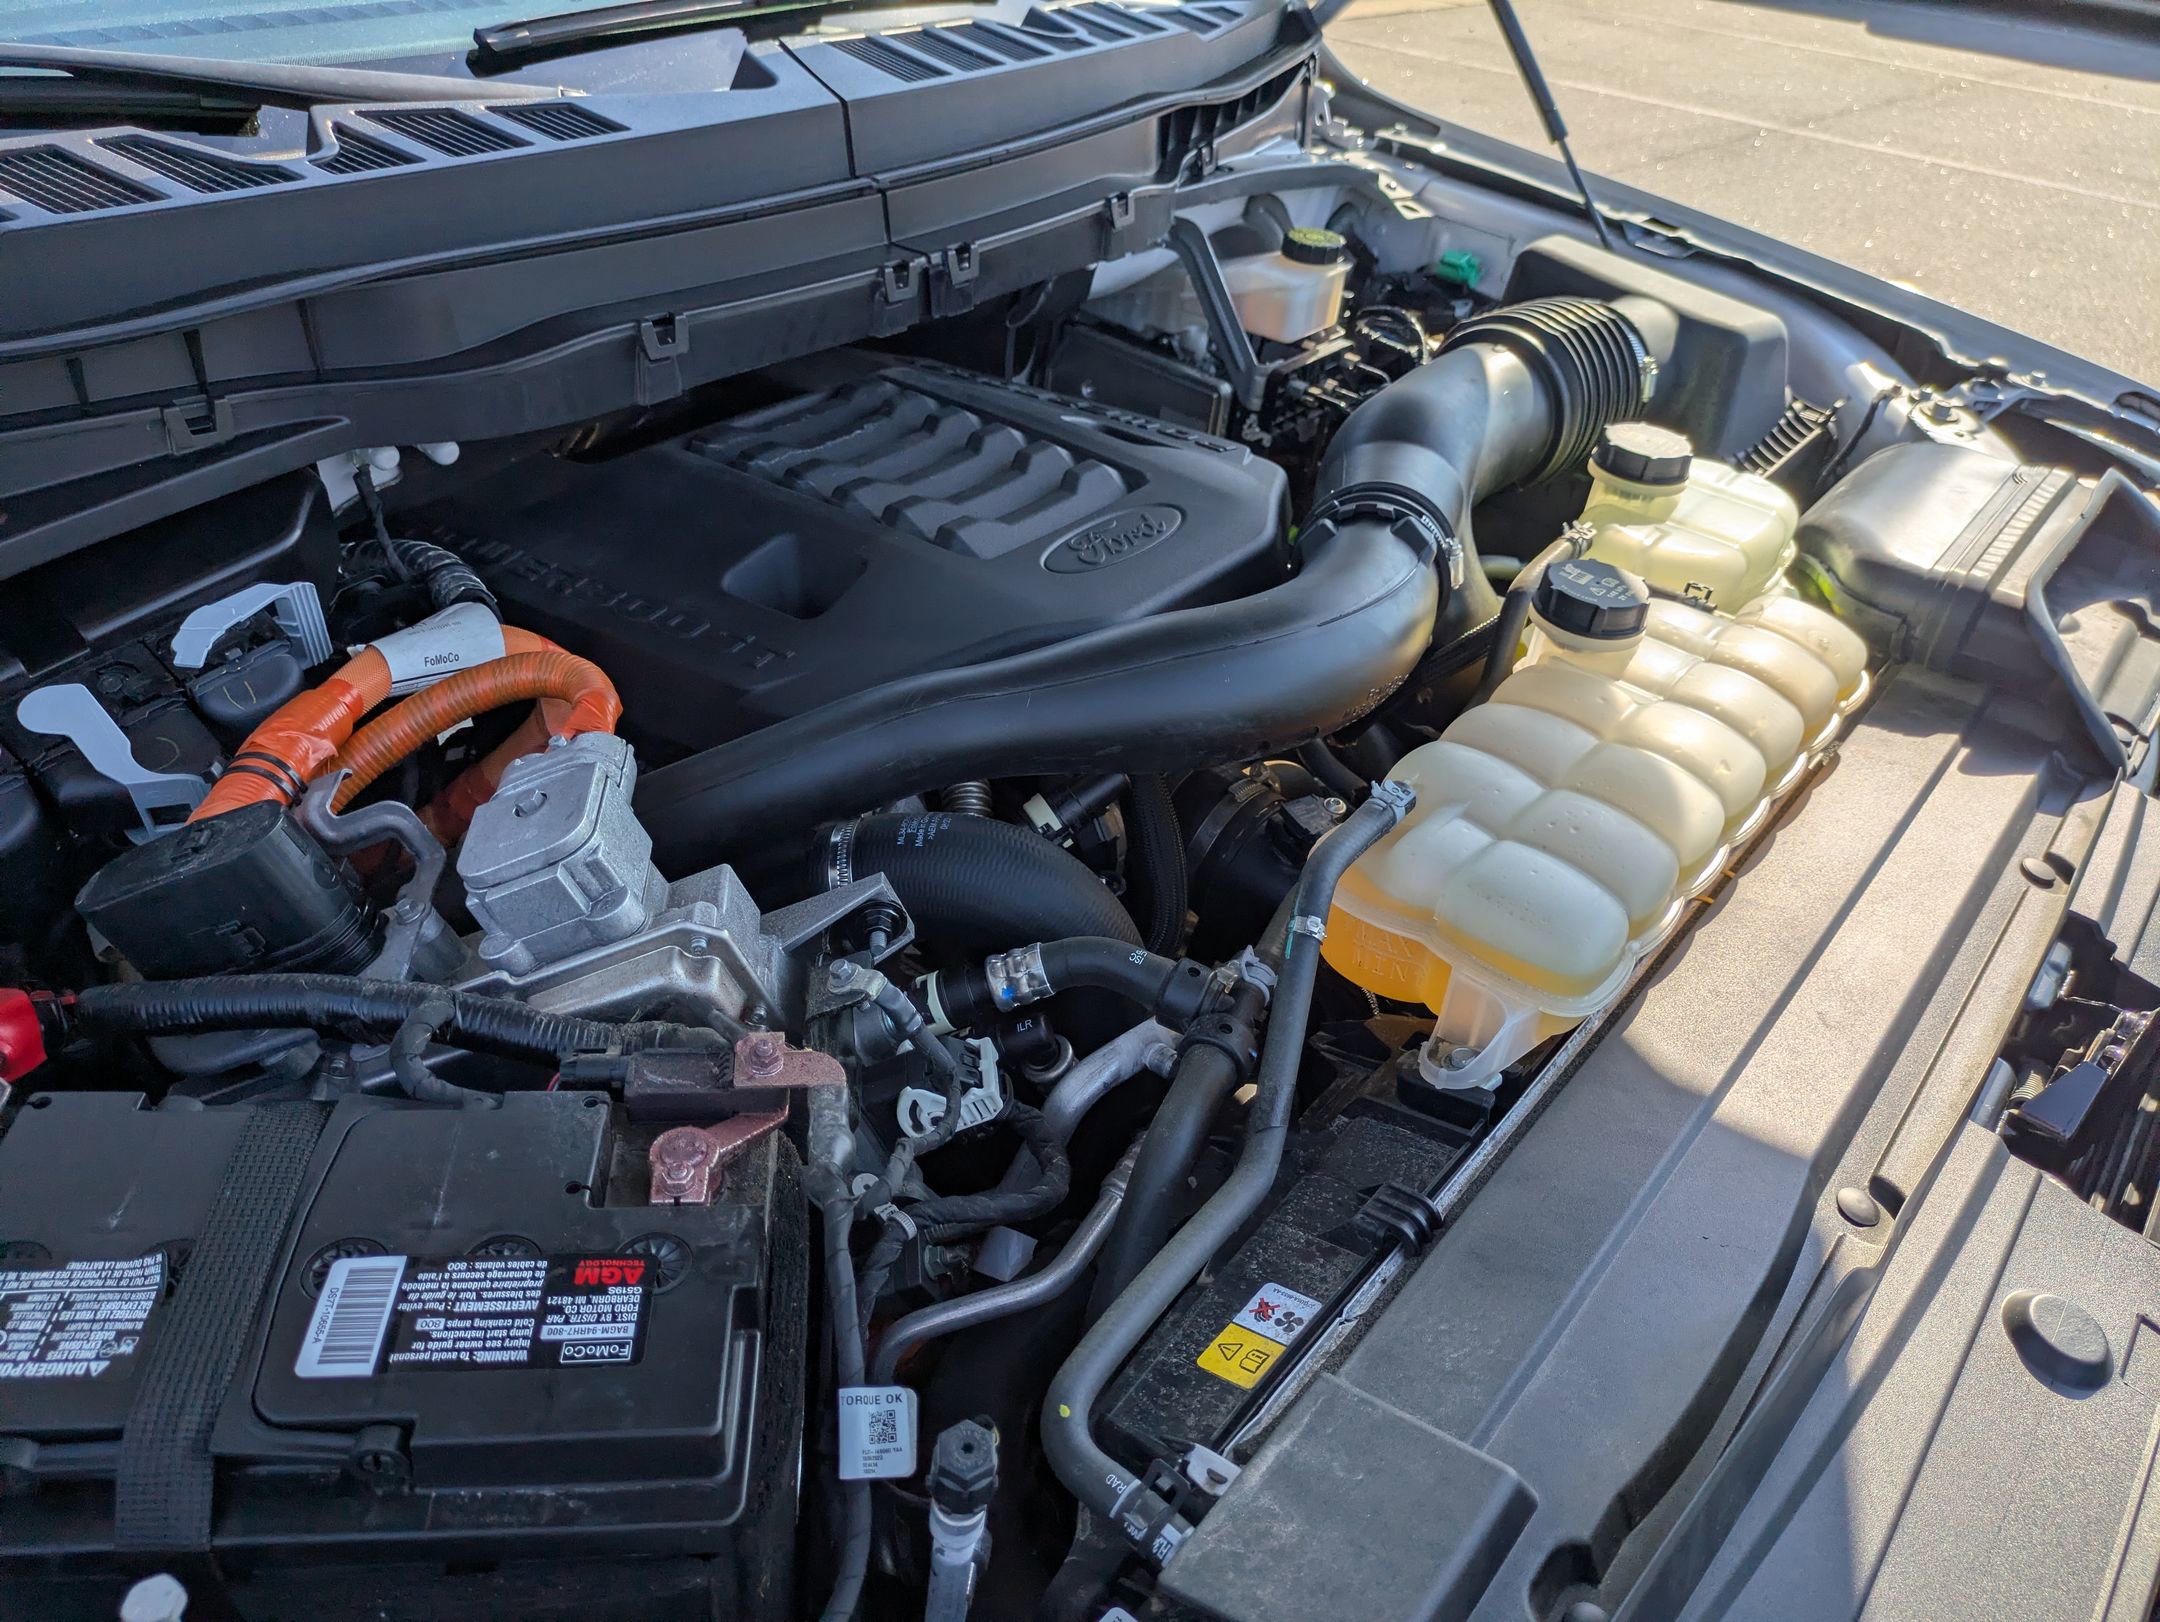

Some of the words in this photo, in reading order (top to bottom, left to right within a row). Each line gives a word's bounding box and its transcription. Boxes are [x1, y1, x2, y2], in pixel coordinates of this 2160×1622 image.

[1068, 513, 1167, 565] Ford
[424, 652, 460, 668] FoMoCo
[1129, 952, 1144, 965] ISC
[1016, 1019, 1033, 1032] ILR
[448, 1262, 467, 1270] 800
[475, 1262, 505, 1270] volants
[507, 1261, 535, 1269] cables
[536, 1260, 547, 1269] de
[452, 1272, 485, 1280] secours
[488, 1270, 532, 1280] demarrage
[535, 1271, 545, 1279] de
[574, 1267, 644, 1285] AGM
[402, 1282, 439, 1291] methode
[442, 1282, 450, 1290] la
[493, 1280, 544, 1289] proprietaire
[421, 1291, 446, 1301] guide
[448, 1292, 456, 1300] le
[459, 1292, 476, 1300] Voir
[480, 1291, 524, 1299] blessures.
[526, 1290, 541, 1299] des
[589, 1295, 640, 1303] DEARBORN,
[547, 1296, 574, 1304] 48121
[575, 1296, 586, 1304] MI
[425, 1302, 445, 1310] Pour
[454, 1300, 539, 1310] AVERTISSEMENT
[563, 1305, 577, 1313] CO.
[580, 1304, 612, 1313] MOTOR
[615, 1304, 639, 1312] FORD
[312, 1287, 339, 1343] DS7T-10655-A
[546, 1315, 565, 1323] PAR
[568, 1314, 597, 1322] DISTR.
[599, 1314, 612, 1322] BY
[615, 1313, 637, 1321] DIST.
[421, 1320, 442, 1328] 800
[446, 1319, 472, 1328] amps
[474, 1319, 512, 1328] cranking
[514, 1319, 535, 1327] Cold
[430, 1330, 484, 1339] instructions.
[486, 1330, 507, 1338] start
[510, 1328, 533, 1337] jump
[547, 1326, 628, 1335] BAGM-94RH7-800
[411, 1342, 425, 1350] for
[428, 1340, 453, 1350] guide
[455, 1340, 483, 1348] owner
[486, 1340, 502, 1348] see
[504, 1338, 530, 1348] injury
[564, 1344, 629, 1357] FoMoCo
[390, 1351, 430, 1362] personal
[434, 1352, 457, 1361] avoid
[460, 1352, 470, 1360] To
[473, 1350, 528, 1361] WARNING:
[840, 1395, 881, 1406] TORQUE
[886, 1393, 903, 1404] OK
[1105, 1474, 1127, 1494] RAD
